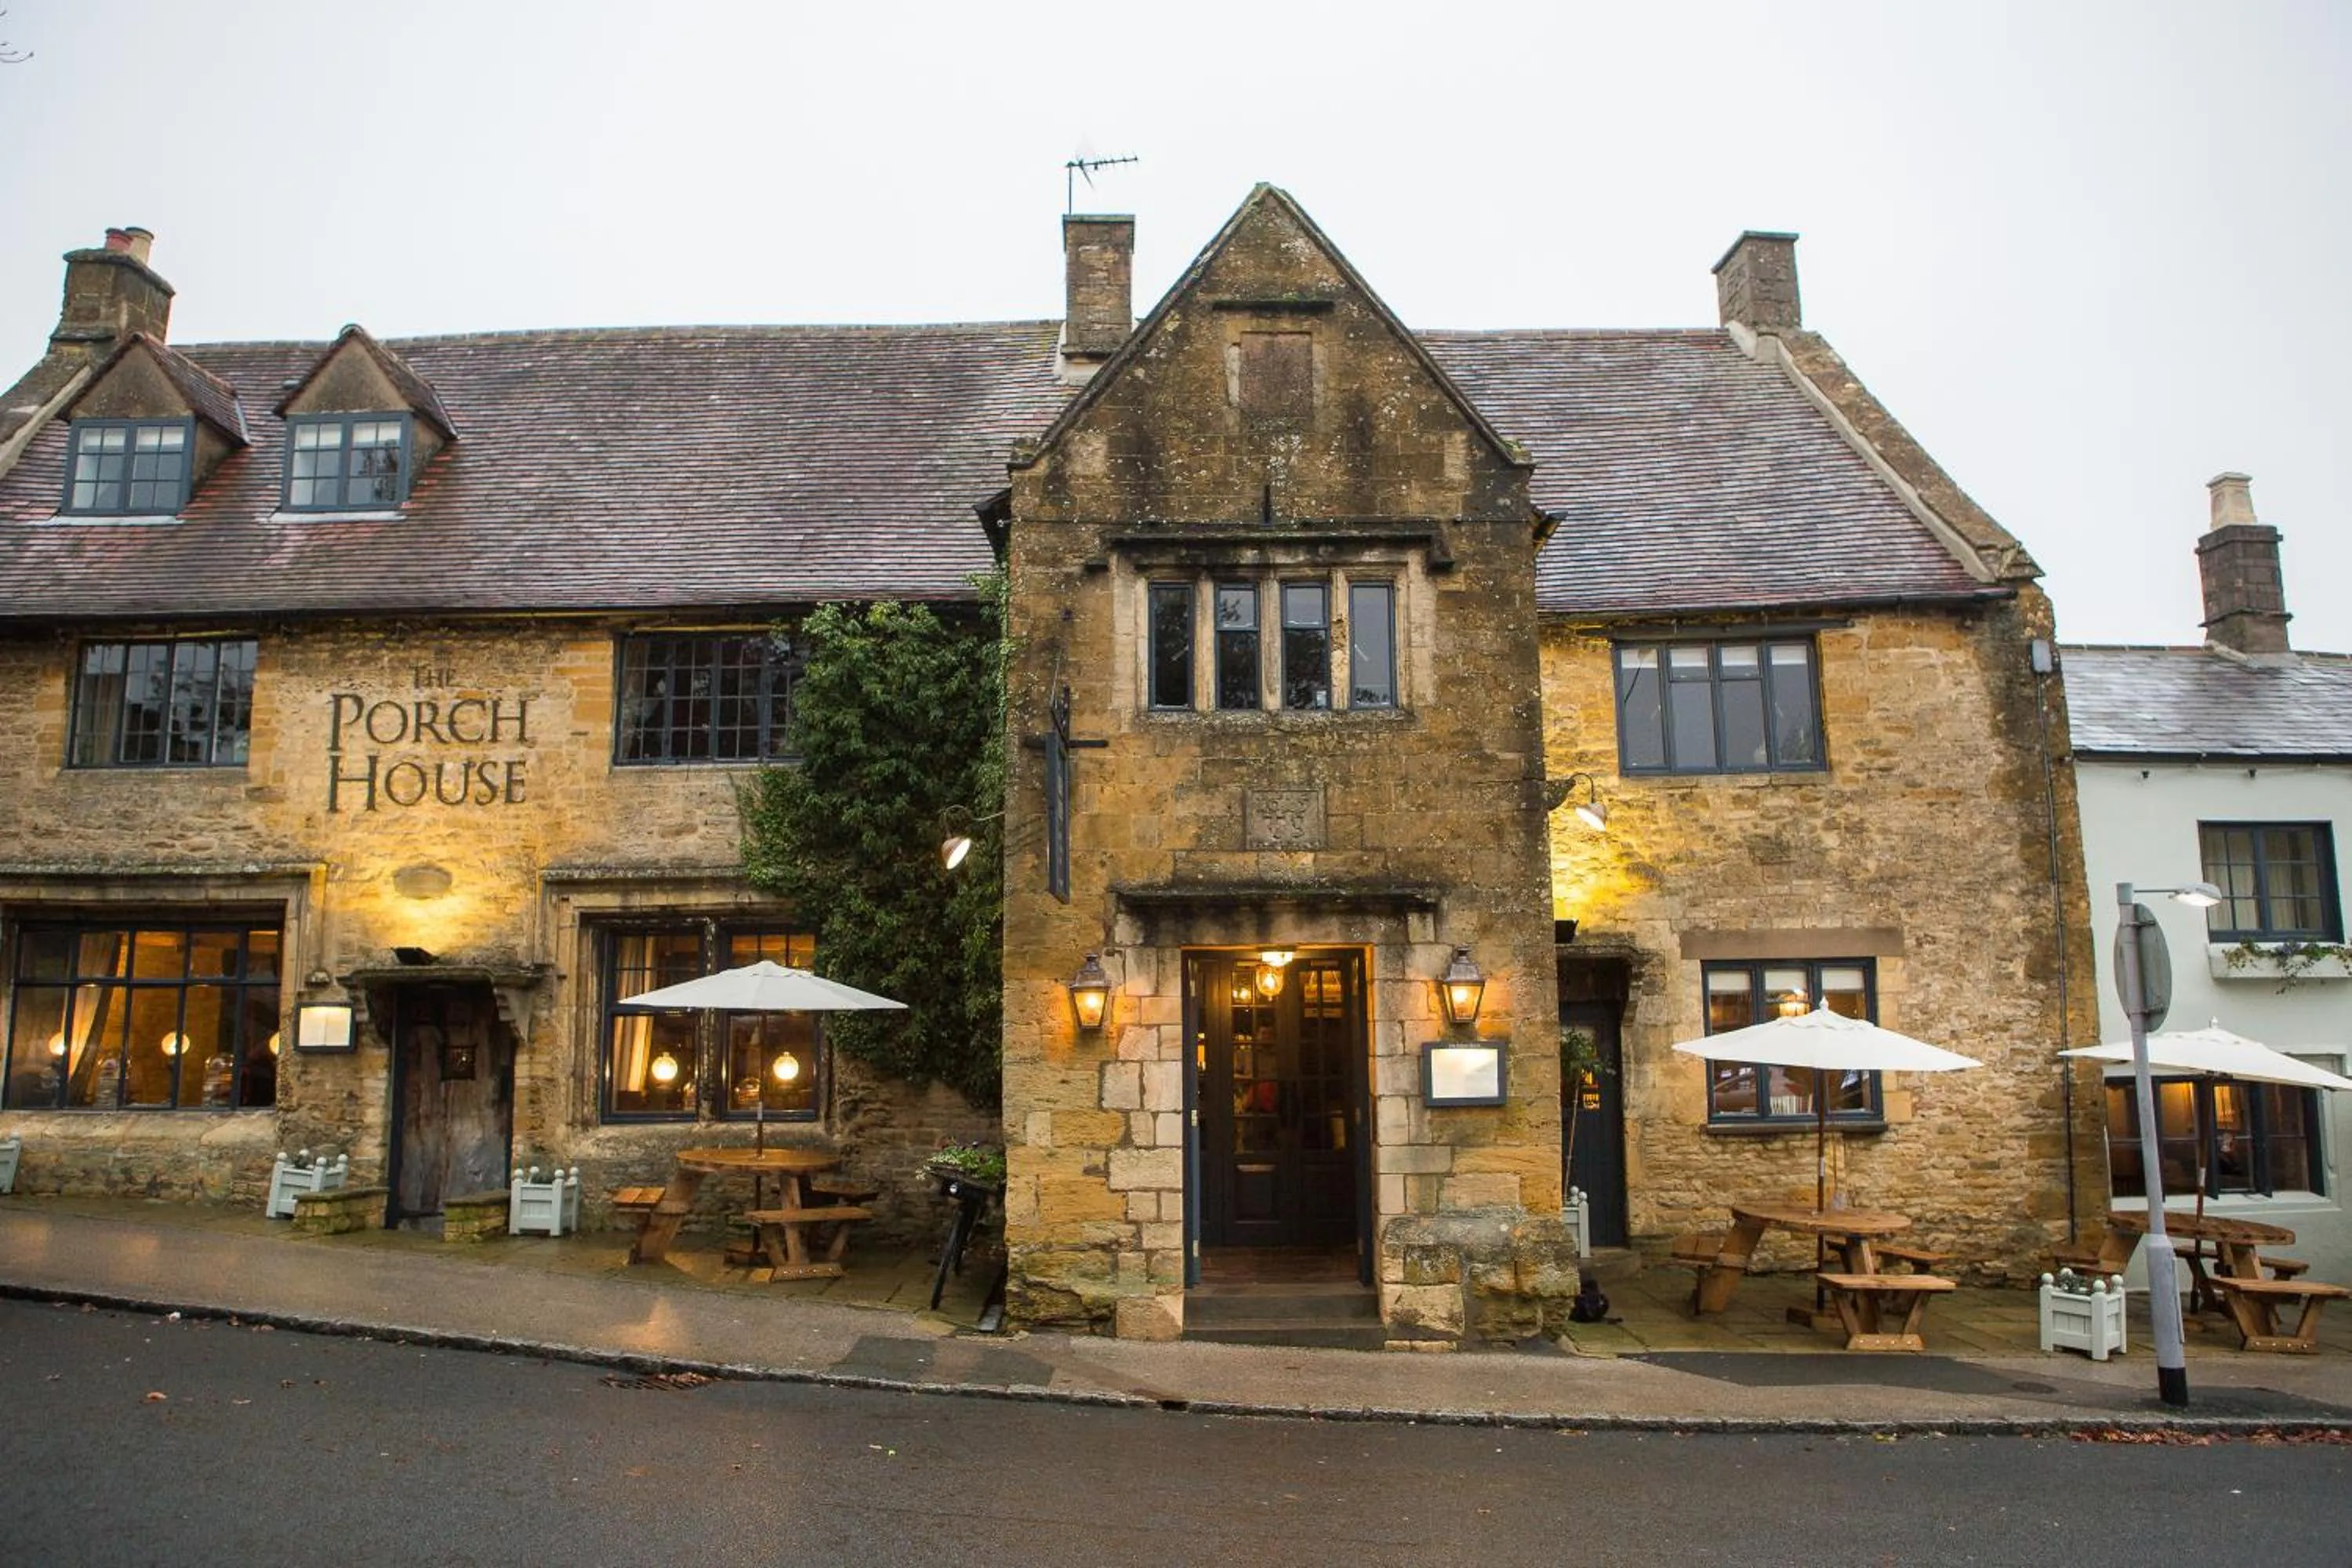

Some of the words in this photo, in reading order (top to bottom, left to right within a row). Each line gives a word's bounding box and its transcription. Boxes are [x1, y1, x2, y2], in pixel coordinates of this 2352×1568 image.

[411, 665, 457, 689] THE
[327, 693, 530, 750] PORCH
[328, 755, 526, 813] HOUSE
